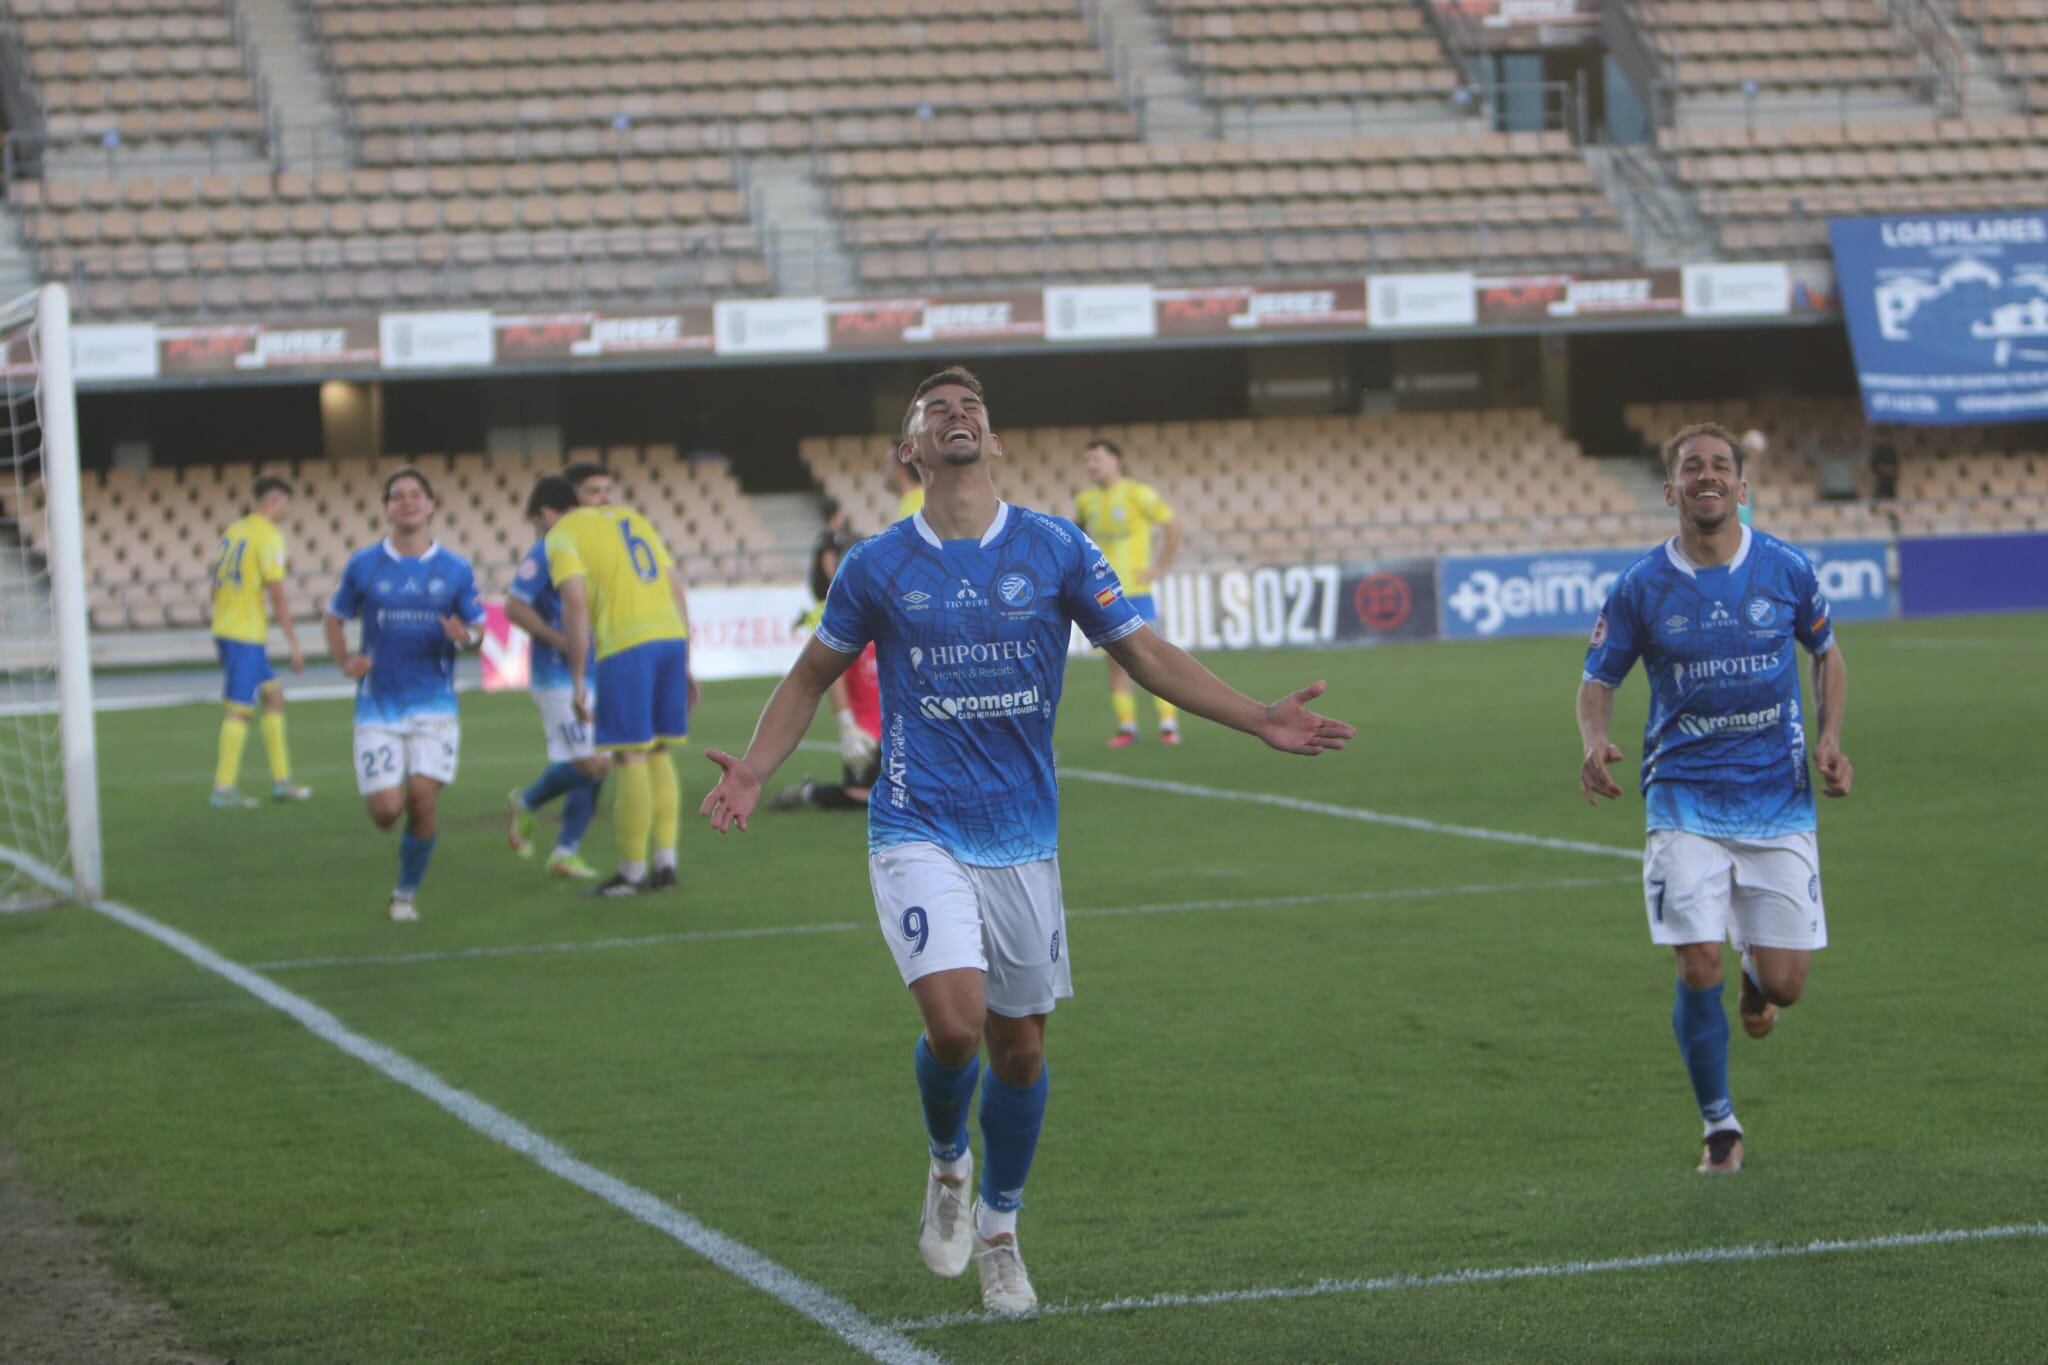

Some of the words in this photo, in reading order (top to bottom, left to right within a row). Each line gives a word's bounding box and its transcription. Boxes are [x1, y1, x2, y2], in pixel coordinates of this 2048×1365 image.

[1881, 222, 1934, 247] LOS
[1936, 217, 2047, 244] PILARES
[618, 518, 659, 584] 6
[1153, 565, 1341, 651] ULSO27
[930, 639, 1037, 667] HIPOTELS
[1688, 651, 1780, 680] HIPOTELS
[979, 665, 1015, 678] Resorts
[956, 685, 1039, 712] romeral
[1709, 703, 1781, 729] romeral
[361, 746, 396, 779] 22
[1650, 880, 1666, 924] 7
[901, 906, 929, 959] 9
